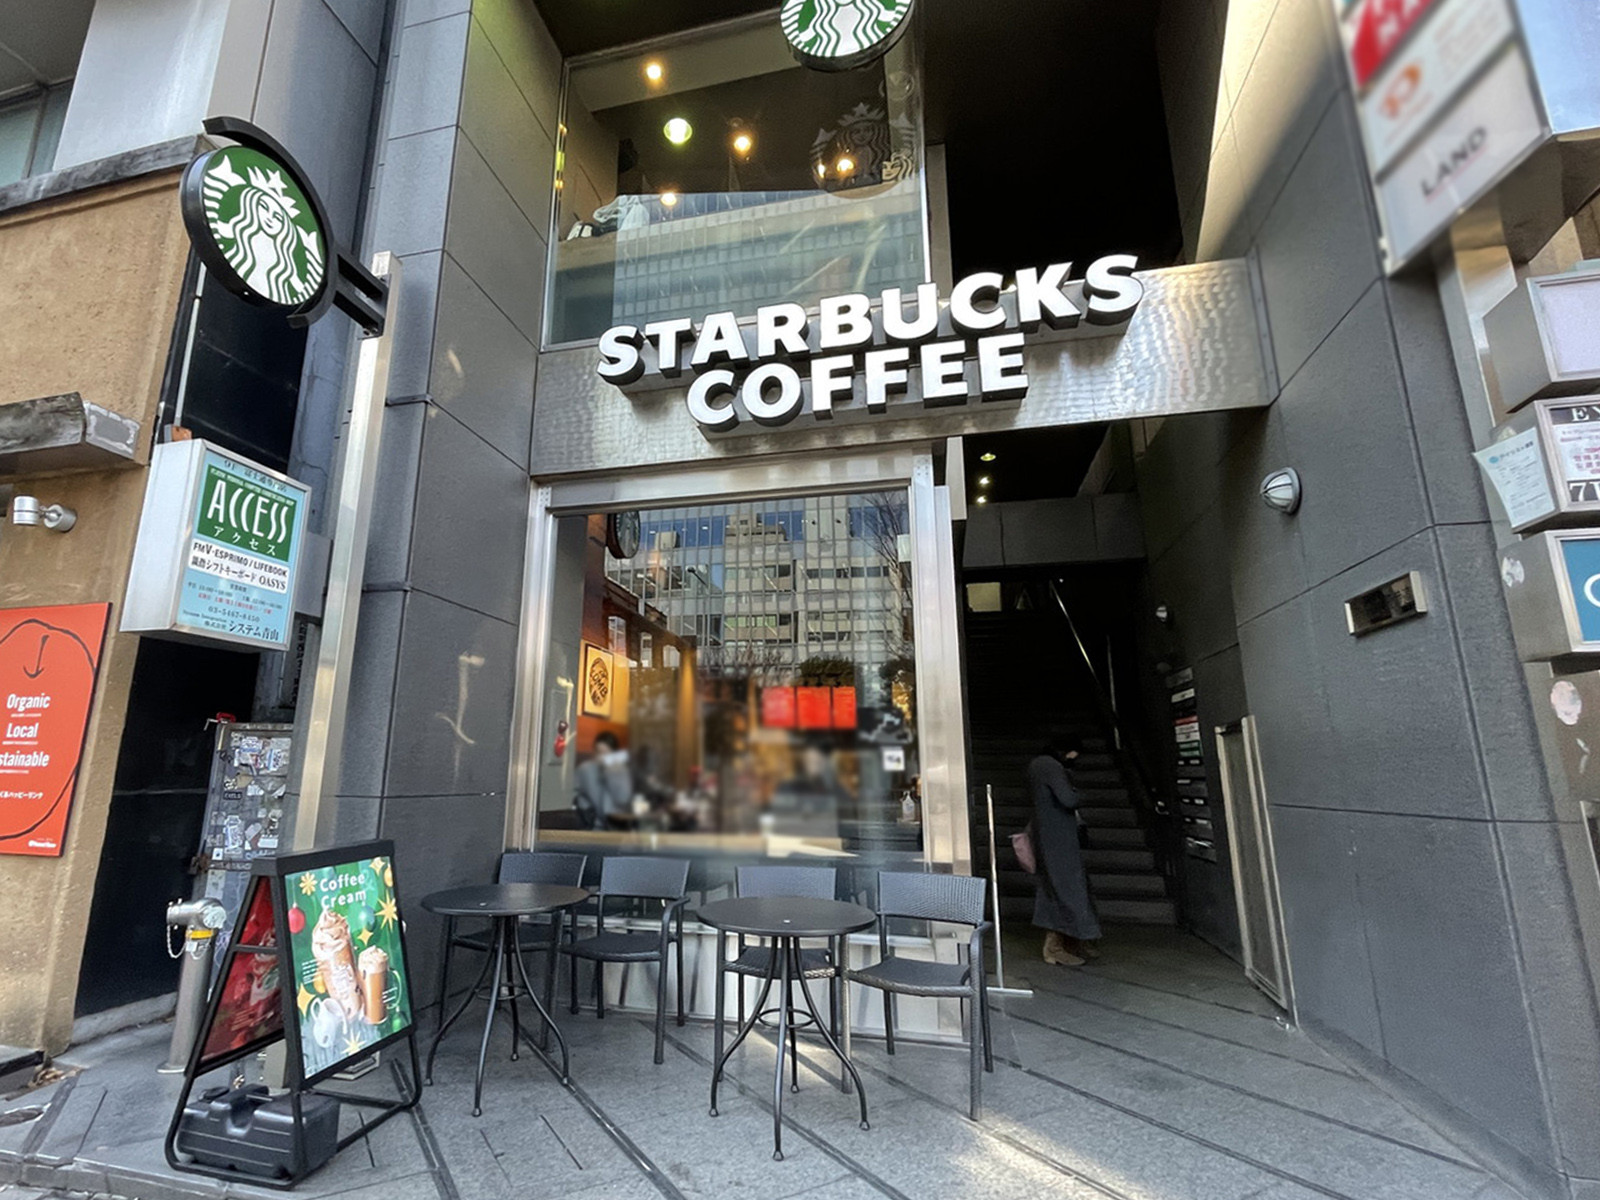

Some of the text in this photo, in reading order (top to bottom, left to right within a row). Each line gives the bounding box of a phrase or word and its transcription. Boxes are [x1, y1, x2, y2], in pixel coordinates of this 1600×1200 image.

[1421, 126, 1487, 197] LAND
[597, 254, 1144, 383] STARBUCKS
[686, 332, 1030, 428] COFFEE
[207, 479, 288, 544] ACCESS
[213, 525, 276, 556] アクセス
[258, 575, 286, 591] OASYS
[6, 692, 51, 712] Organic
[6, 722, 39, 738] Local
[320, 873, 365, 893] Coffee
[321, 890, 366, 909] Cream
